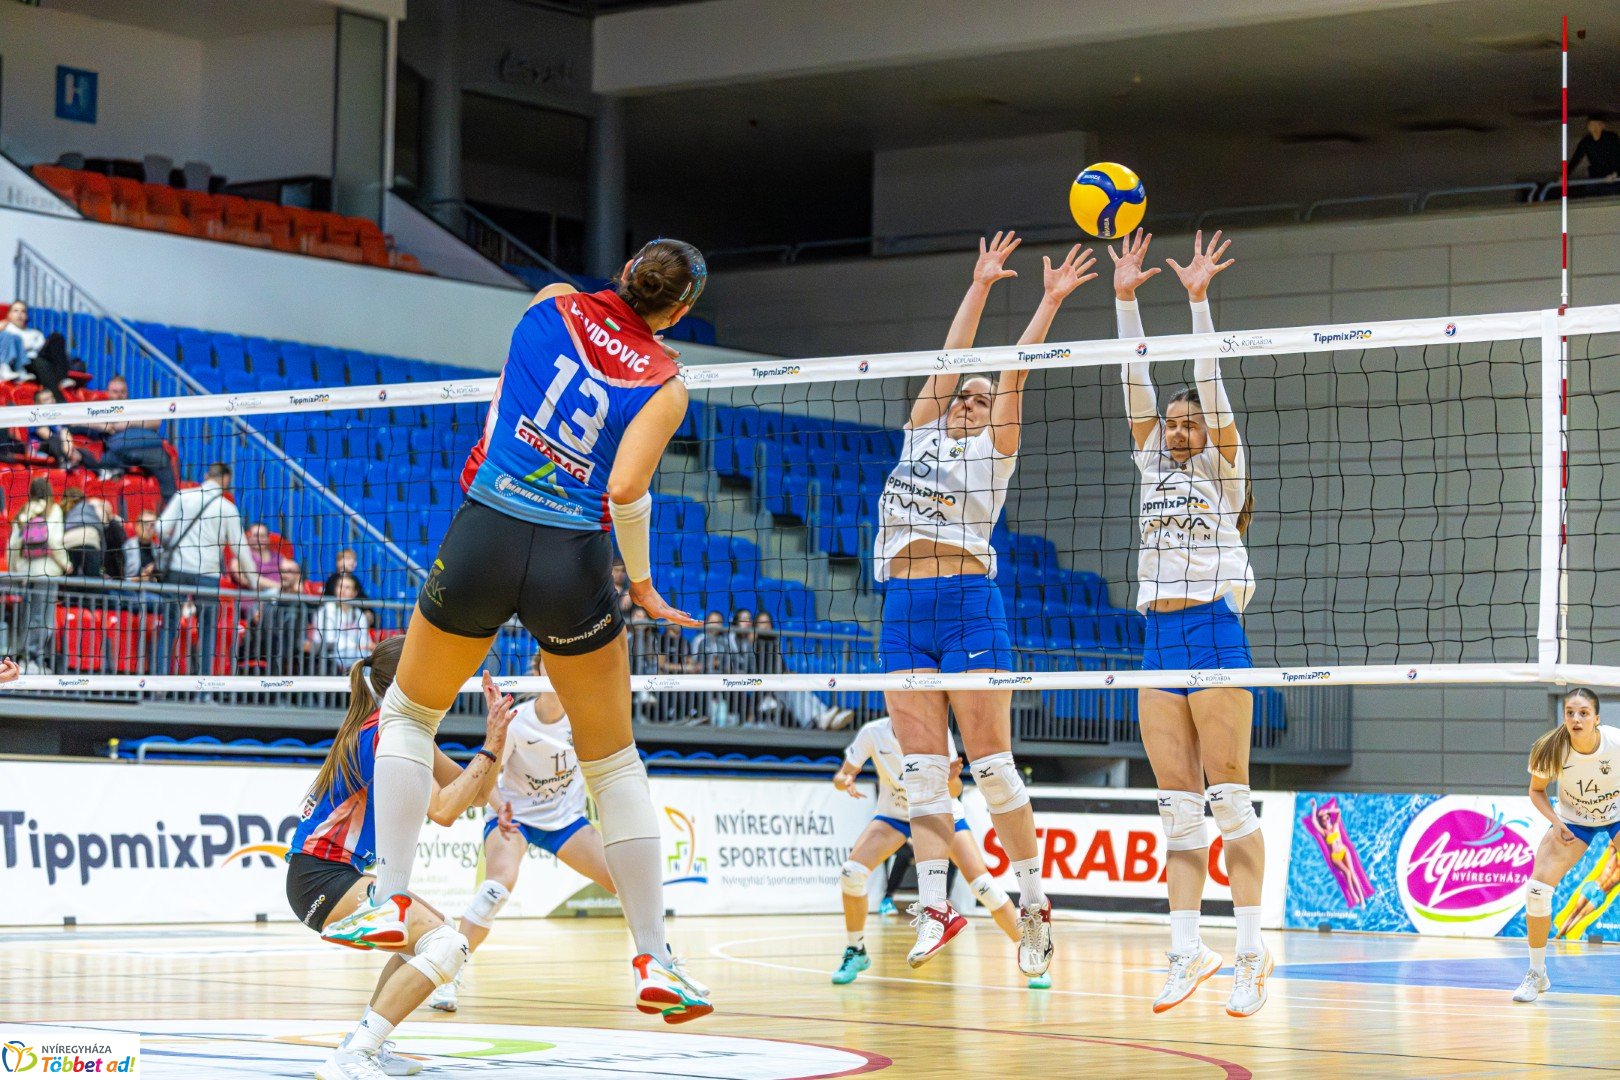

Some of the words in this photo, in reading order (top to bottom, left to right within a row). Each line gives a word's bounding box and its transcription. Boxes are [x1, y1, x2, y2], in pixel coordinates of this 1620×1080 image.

[1312, 329, 1373, 343] TippmixPRO
[1017, 349, 1071, 362] TippmixPRO
[752, 365, 801, 378] TippmixPRO
[533, 354, 610, 455] 13
[912, 450, 938, 478] 5
[887, 476, 957, 506] ppmixPRO
[1142, 496, 1210, 514] ppmixPRO
[547, 613, 613, 645] TippmixPRO
[987, 676, 1033, 687] TippmixPRO
[1281, 671, 1331, 682] TippmixPRO
[550, 749, 568, 772] 11
[1576, 778, 1601, 797] 14
[715, 808, 835, 836] NYÍREGYHÁZI
[719, 846, 853, 868] SPORTCENTRU
[983, 827, 1230, 887] SRAB
[1407, 831, 1536, 908] Aquarius
[1451, 870, 1529, 885] NYÍREGYHÁZA
